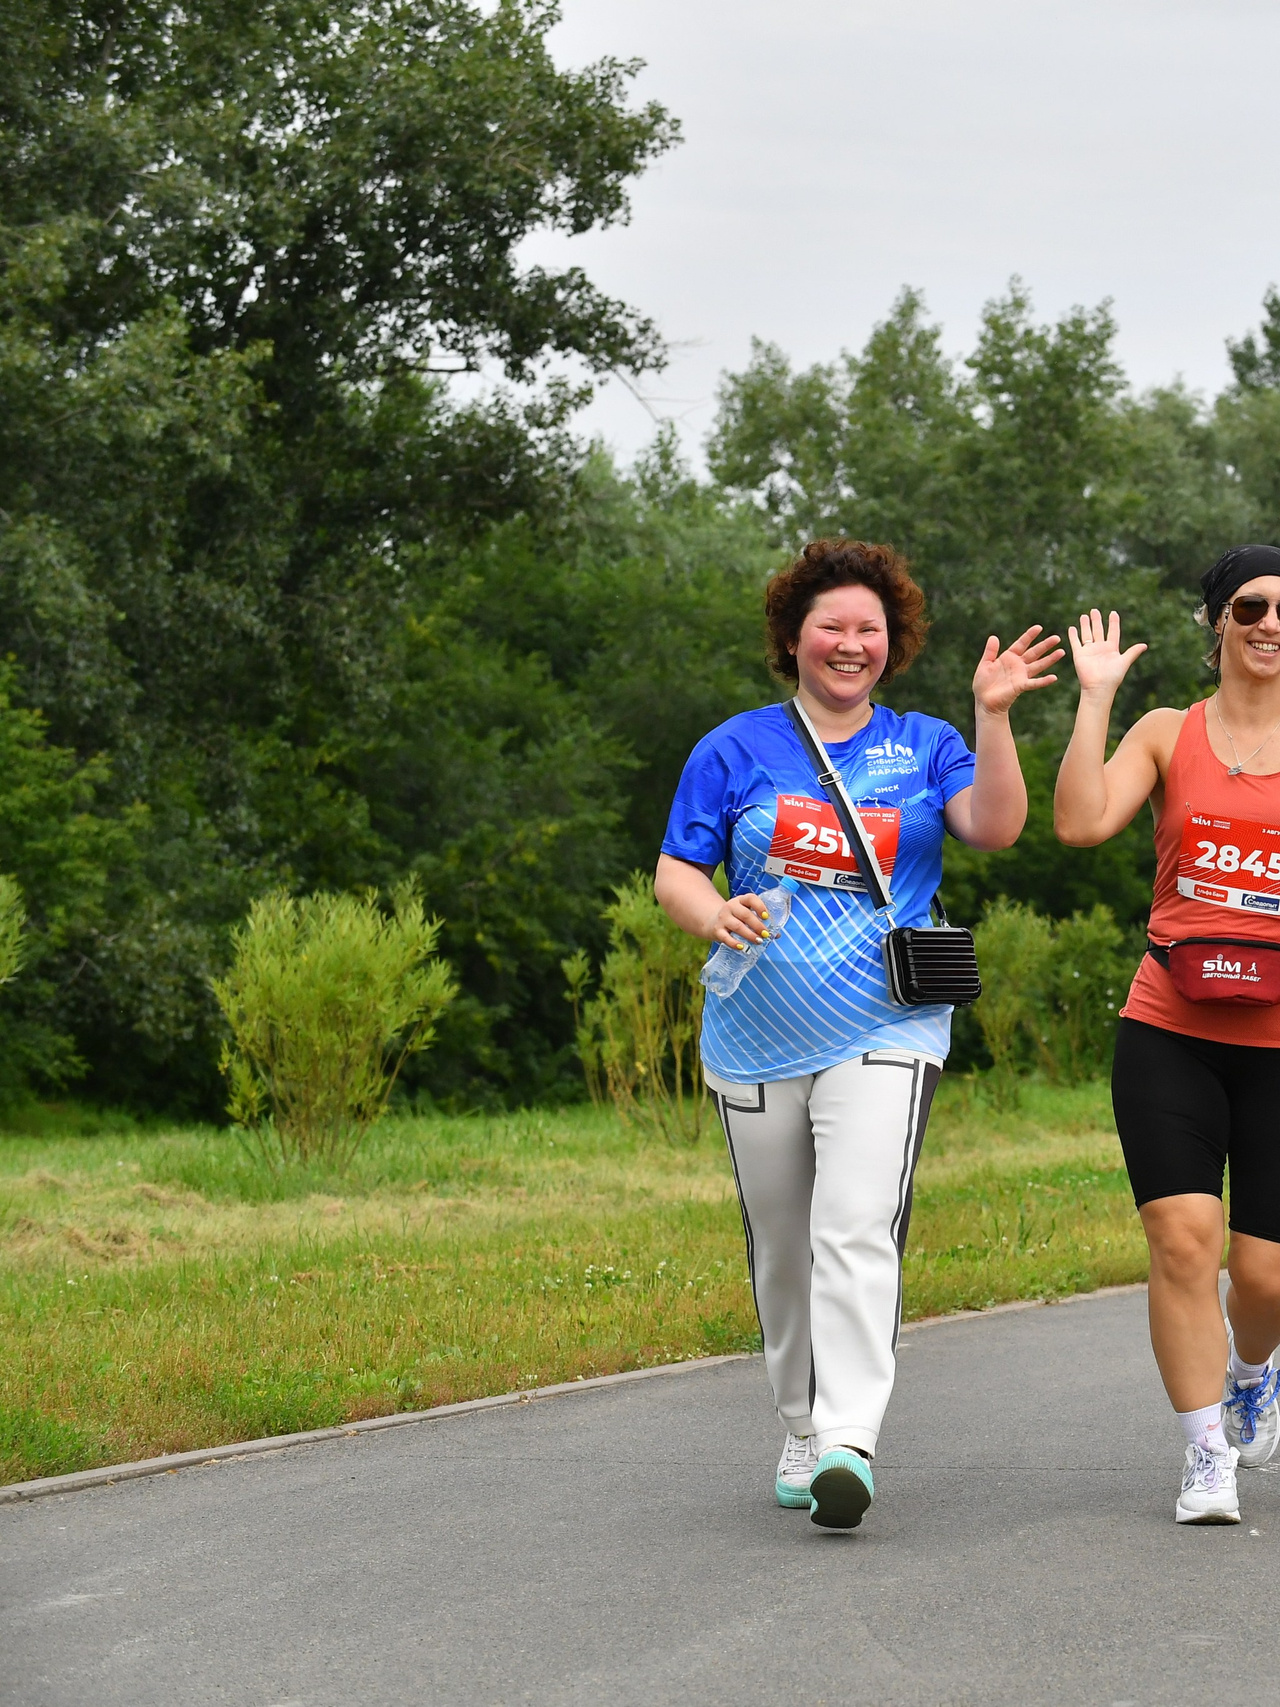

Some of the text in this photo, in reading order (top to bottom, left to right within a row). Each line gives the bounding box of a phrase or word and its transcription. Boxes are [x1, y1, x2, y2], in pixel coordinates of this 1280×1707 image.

[874, 784, 900, 794] ОМСК
[787, 866, 818, 878] Альфа Банк
[840, 877, 866, 886] Следоп
[1196, 887, 1212, 896] Альфа
[1247, 898, 1278, 909] Следопыт
[1201, 972, 1262, 982] ЦВЕТОЧНЫЙ ЗАБЕГ
